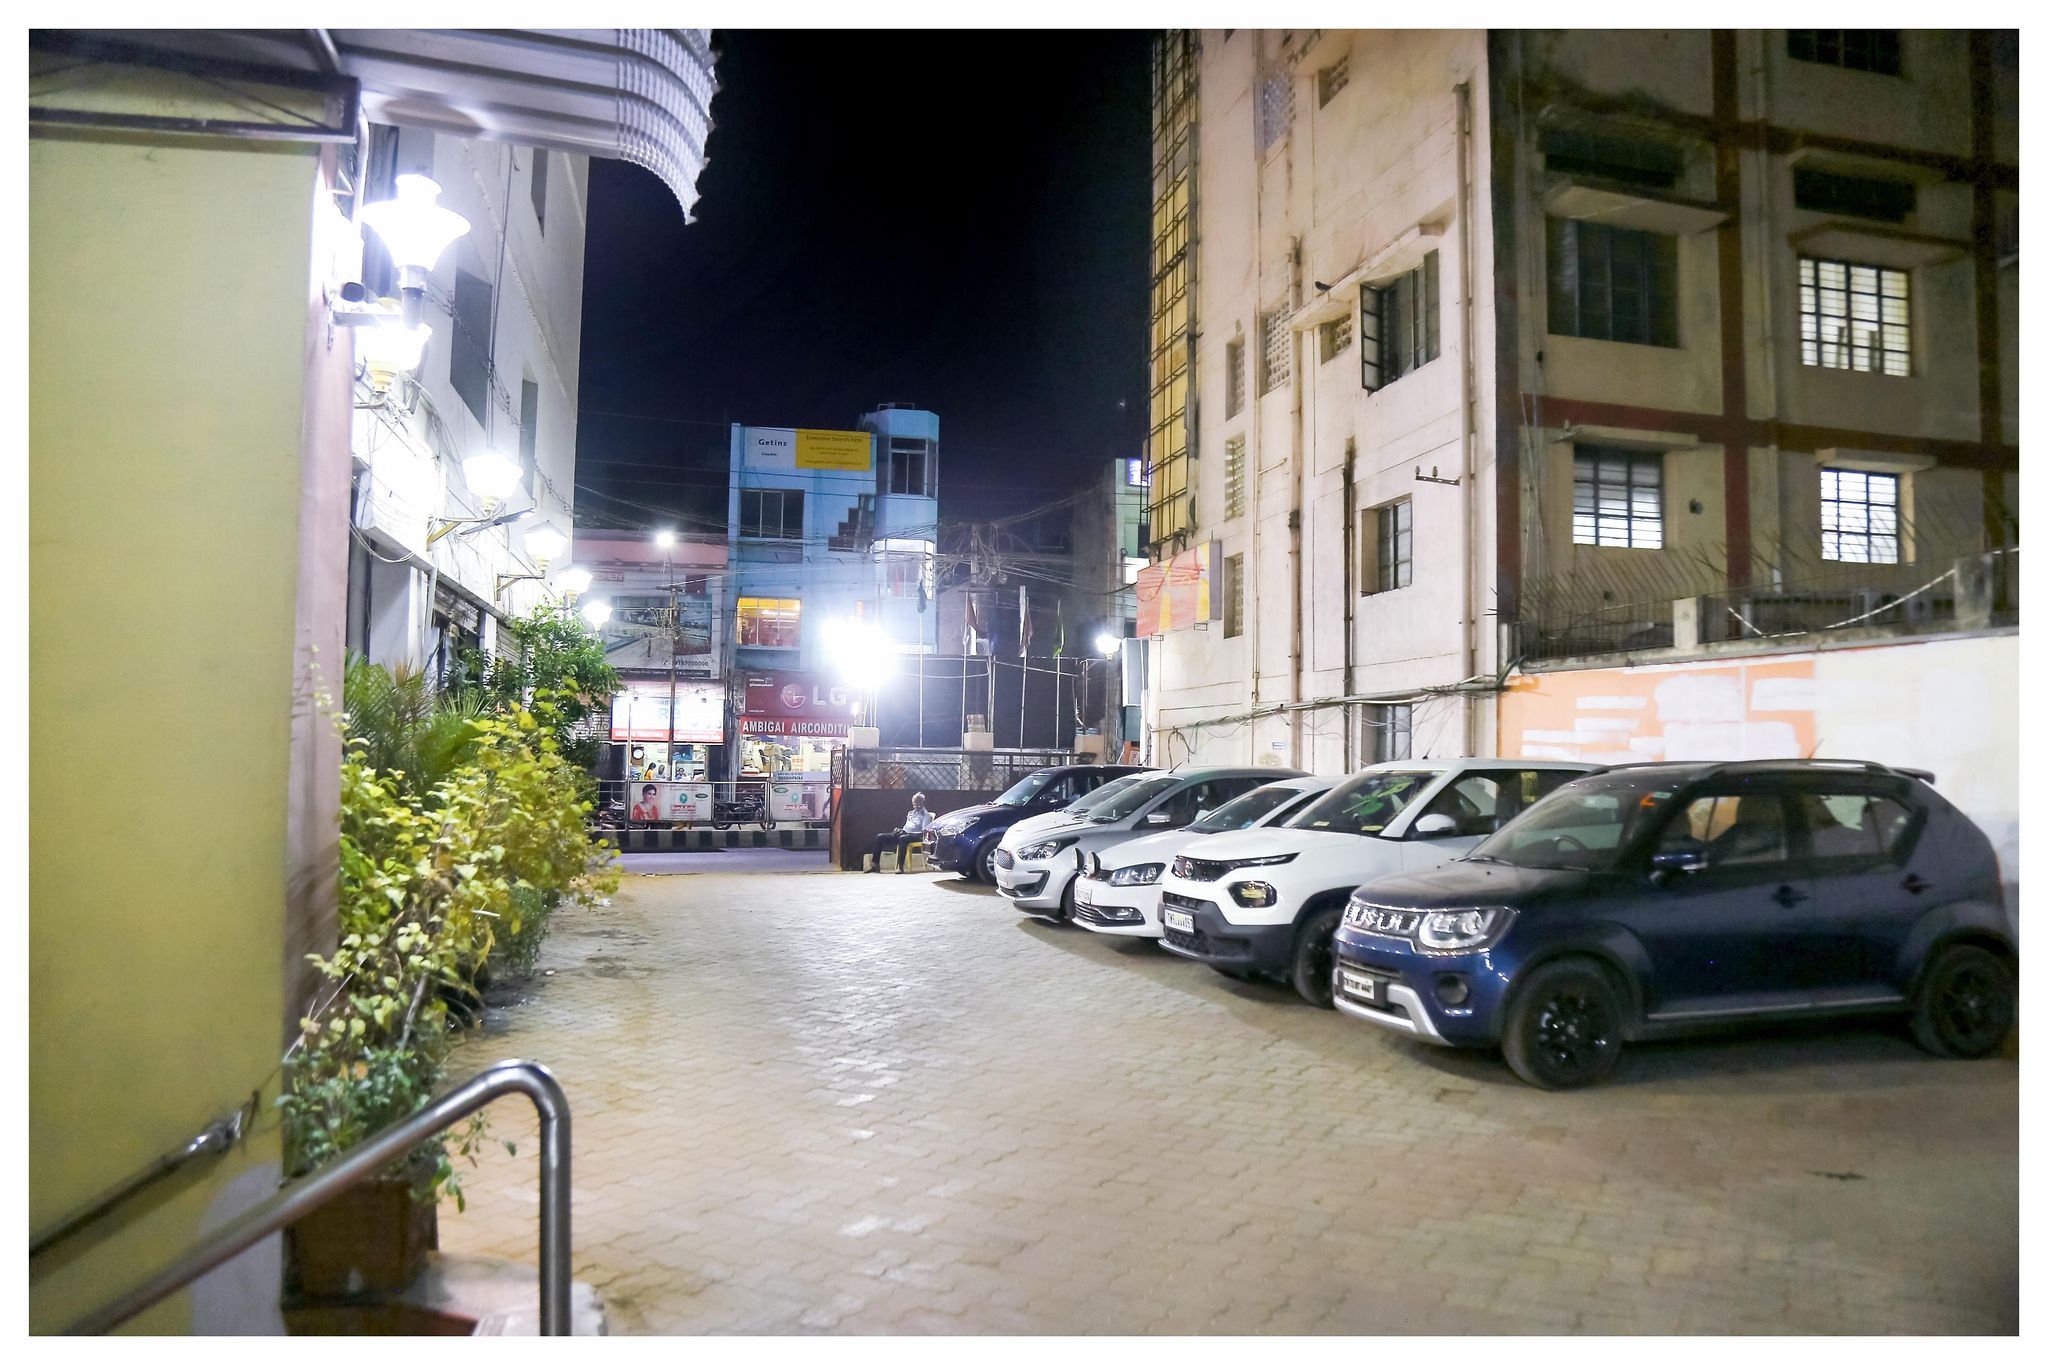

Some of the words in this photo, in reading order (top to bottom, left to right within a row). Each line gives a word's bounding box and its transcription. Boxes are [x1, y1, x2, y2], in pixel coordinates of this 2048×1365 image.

[758, 438, 788, 447] Getinz
[812, 685, 847, 705] LG
[742, 721, 785, 733] AMBIGAI
